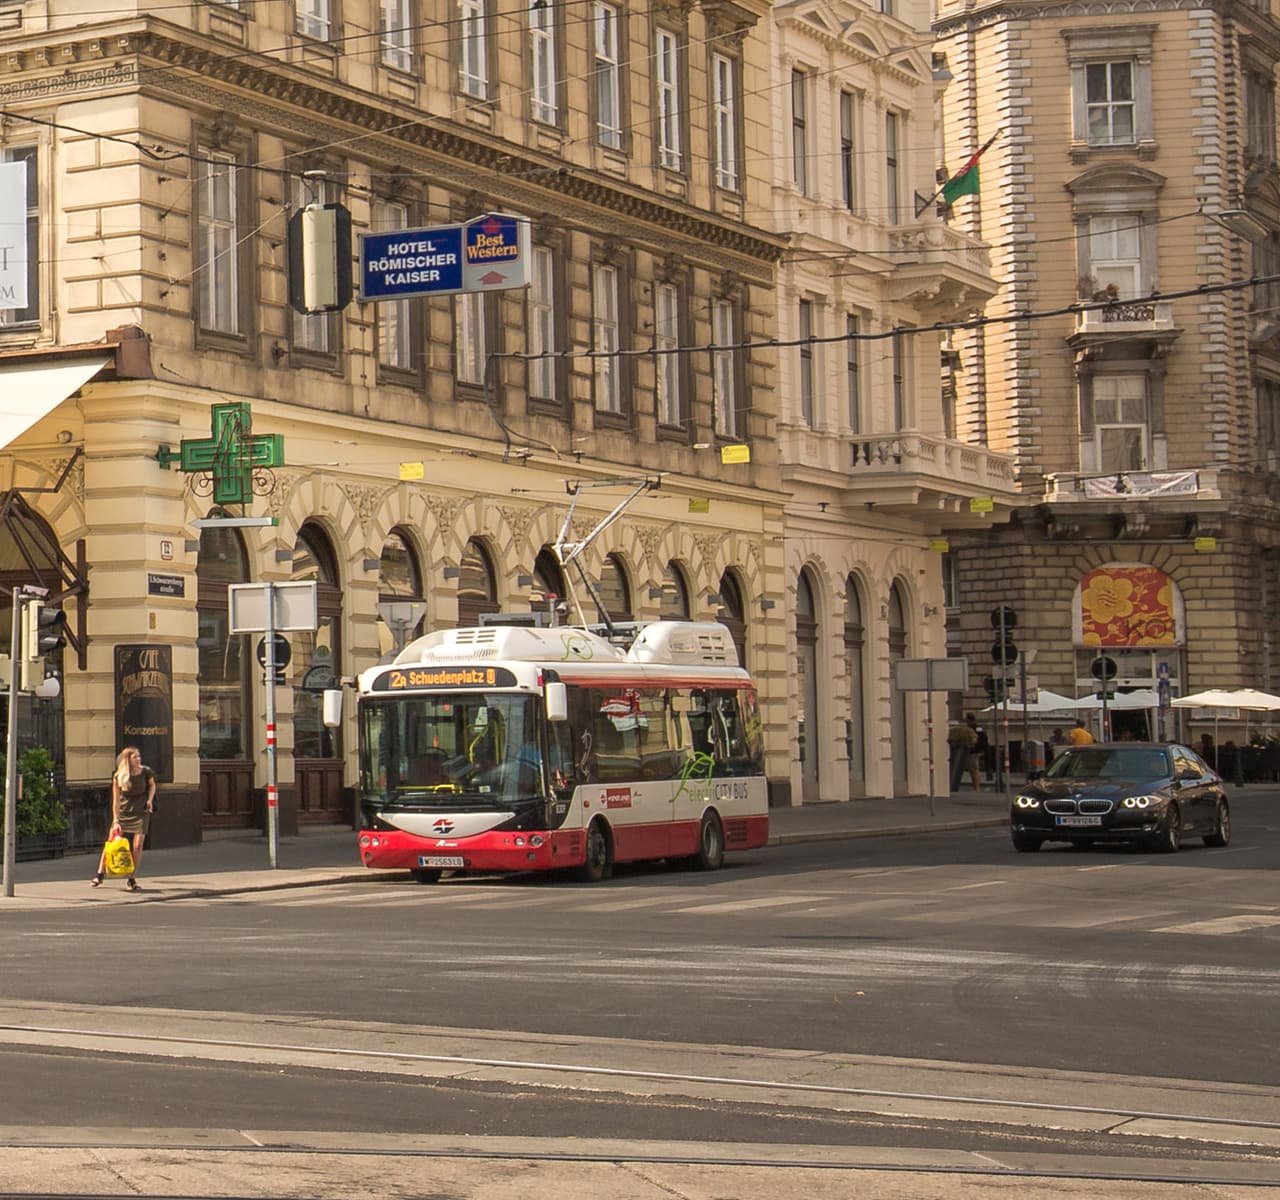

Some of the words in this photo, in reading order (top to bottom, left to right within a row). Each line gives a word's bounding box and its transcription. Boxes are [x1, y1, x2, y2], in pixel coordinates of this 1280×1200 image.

[388, 240, 436, 256] HOTEL
[476, 233, 505, 249] Best
[467, 244, 518, 260] Western
[368, 252, 457, 273] RÖMISCHER
[384, 269, 440, 286] KAISER
[391, 671, 406, 688] 2A
[409, 669, 485, 686] Schwedenplatz
